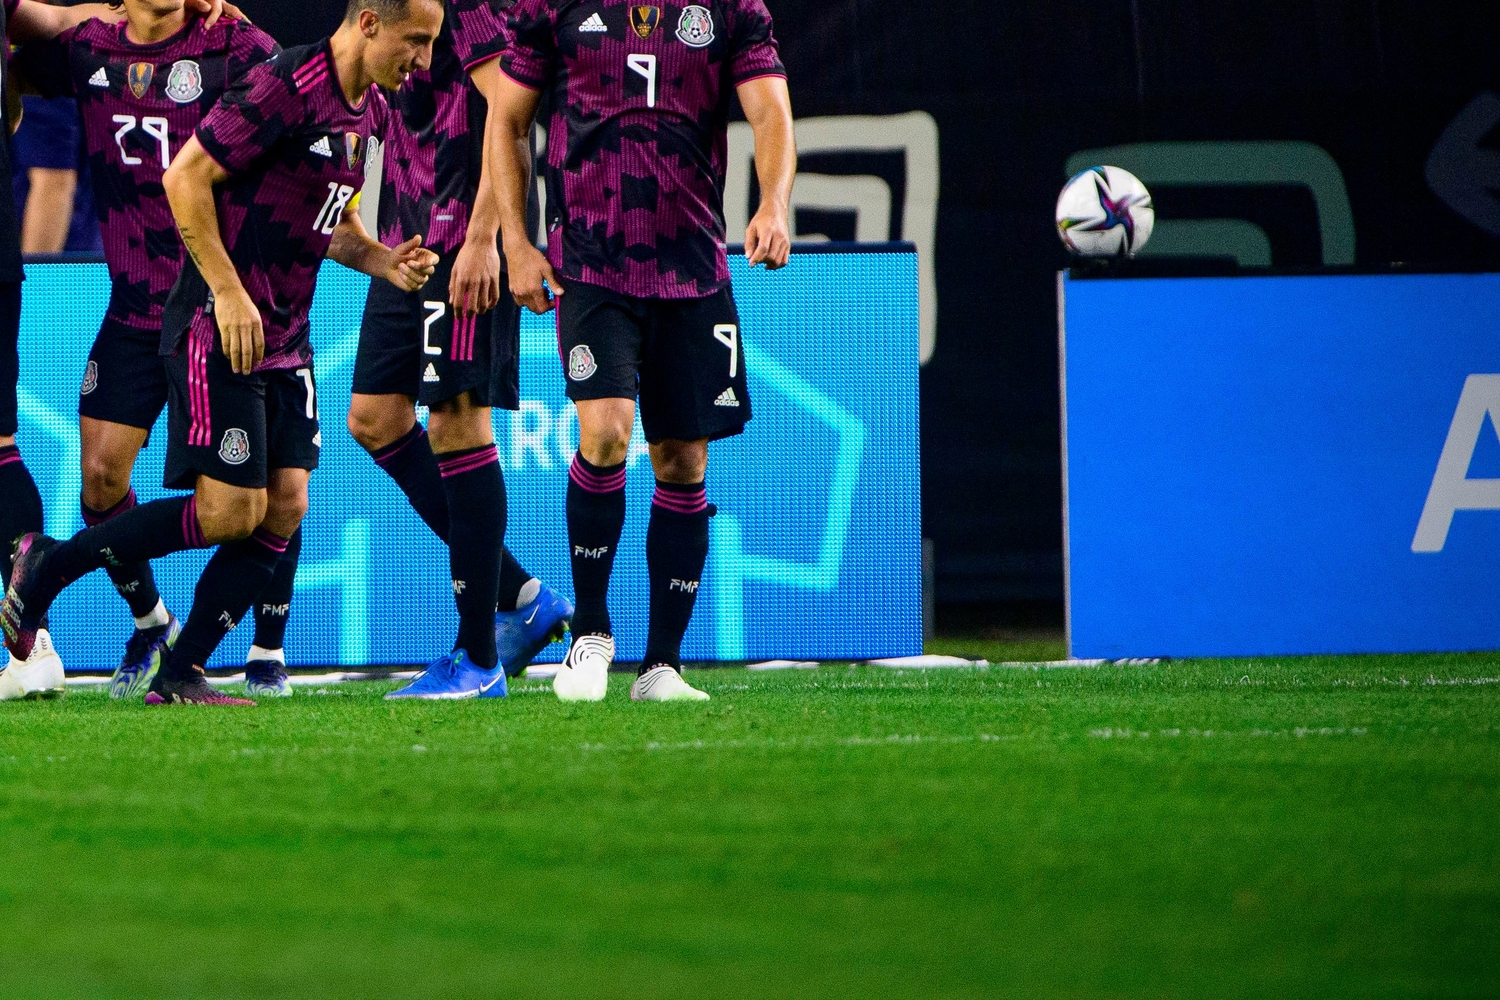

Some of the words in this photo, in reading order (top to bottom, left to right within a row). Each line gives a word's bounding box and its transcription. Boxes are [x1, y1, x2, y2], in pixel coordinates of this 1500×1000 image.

[578, 24, 608, 33] adidas
[627, 53, 657, 108] 9
[112, 114, 170, 170] 29
[312, 181, 355, 235] 18
[423, 300, 446, 355] 2
[713, 323, 738, 378] 9
[713, 398, 740, 407] adidas
[574, 545, 609, 559] FMF
[670, 578, 699, 594] FMF
[218, 610, 237, 631] FM
[262, 603, 290, 617] FMF
